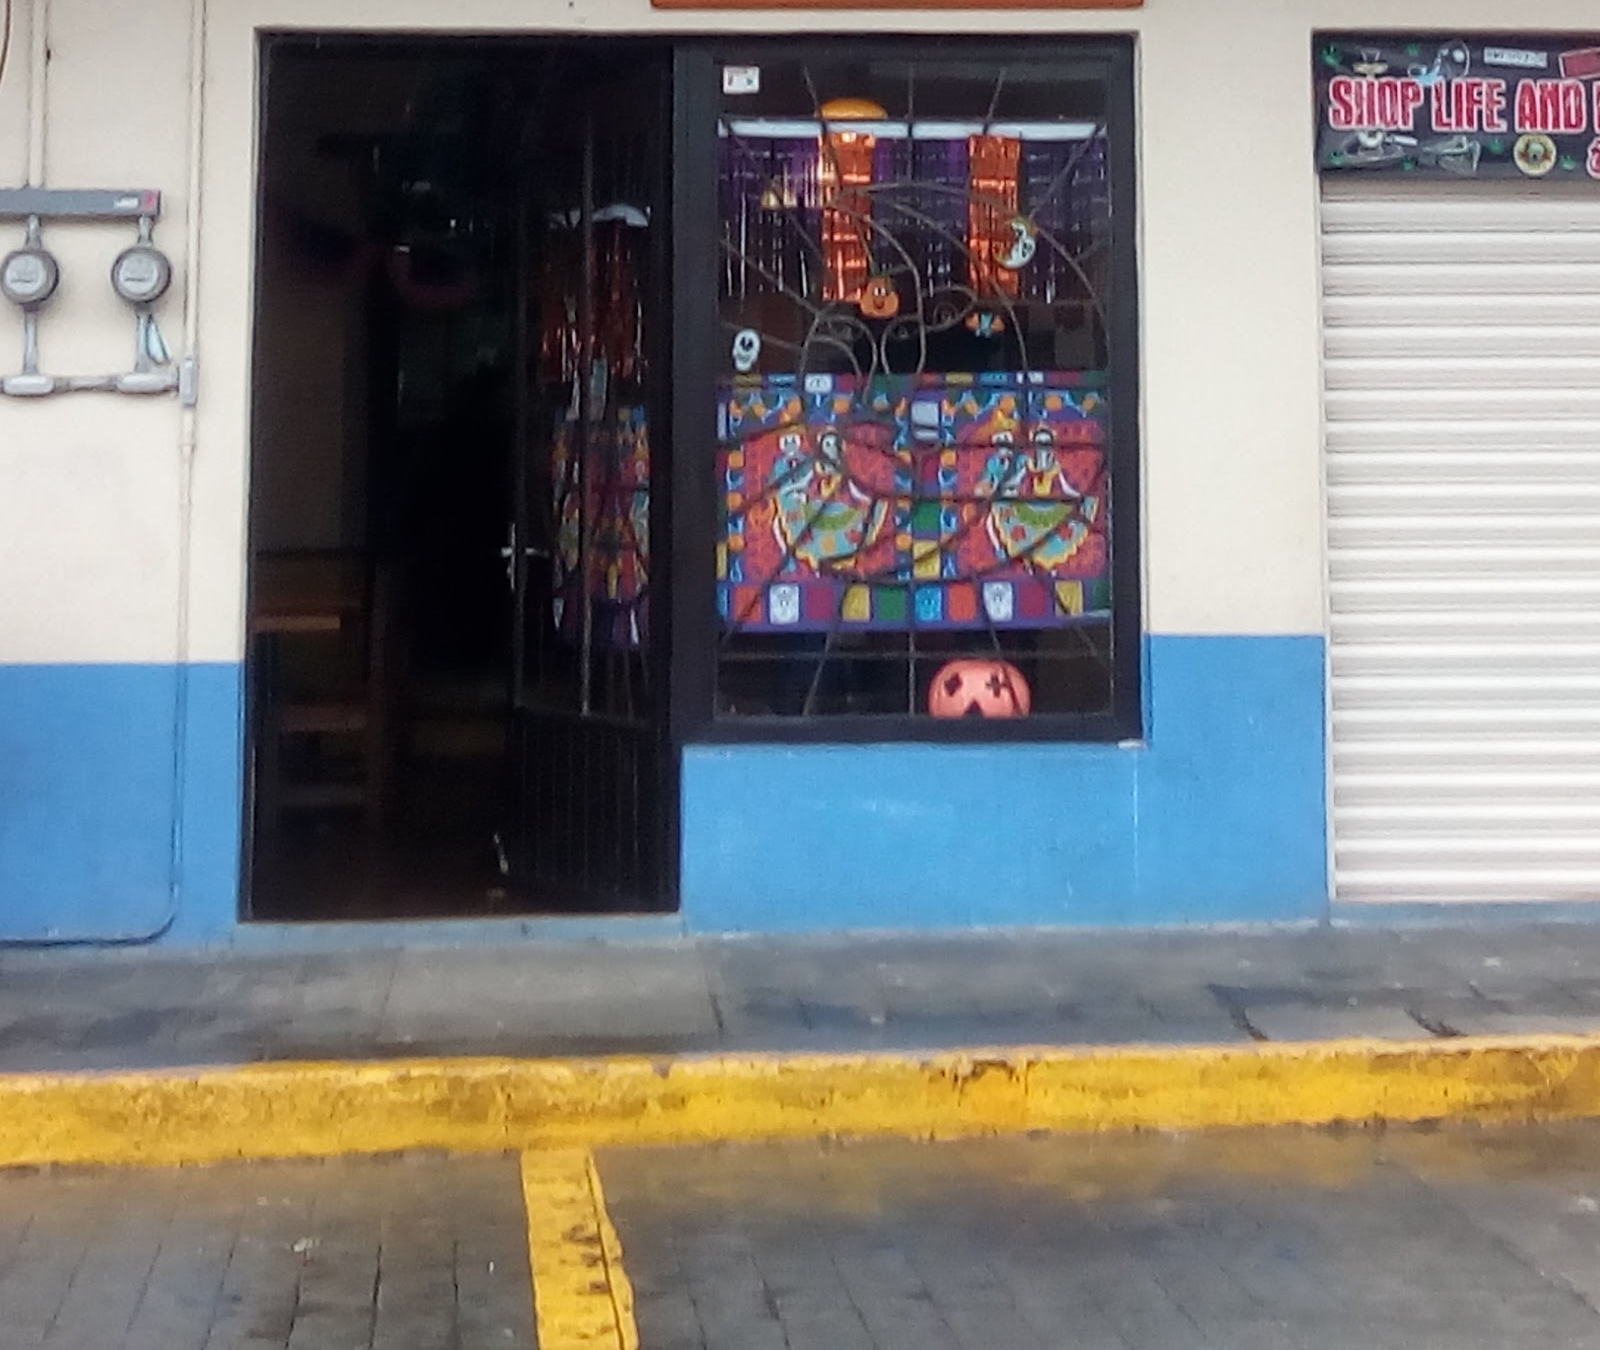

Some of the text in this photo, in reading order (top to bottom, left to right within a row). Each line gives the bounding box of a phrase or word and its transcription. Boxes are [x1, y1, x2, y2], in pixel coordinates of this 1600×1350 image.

[1329, 76, 1424, 131] SHOP
[1431, 77, 1508, 133] LIFE
[1514, 77, 1586, 134] AND
